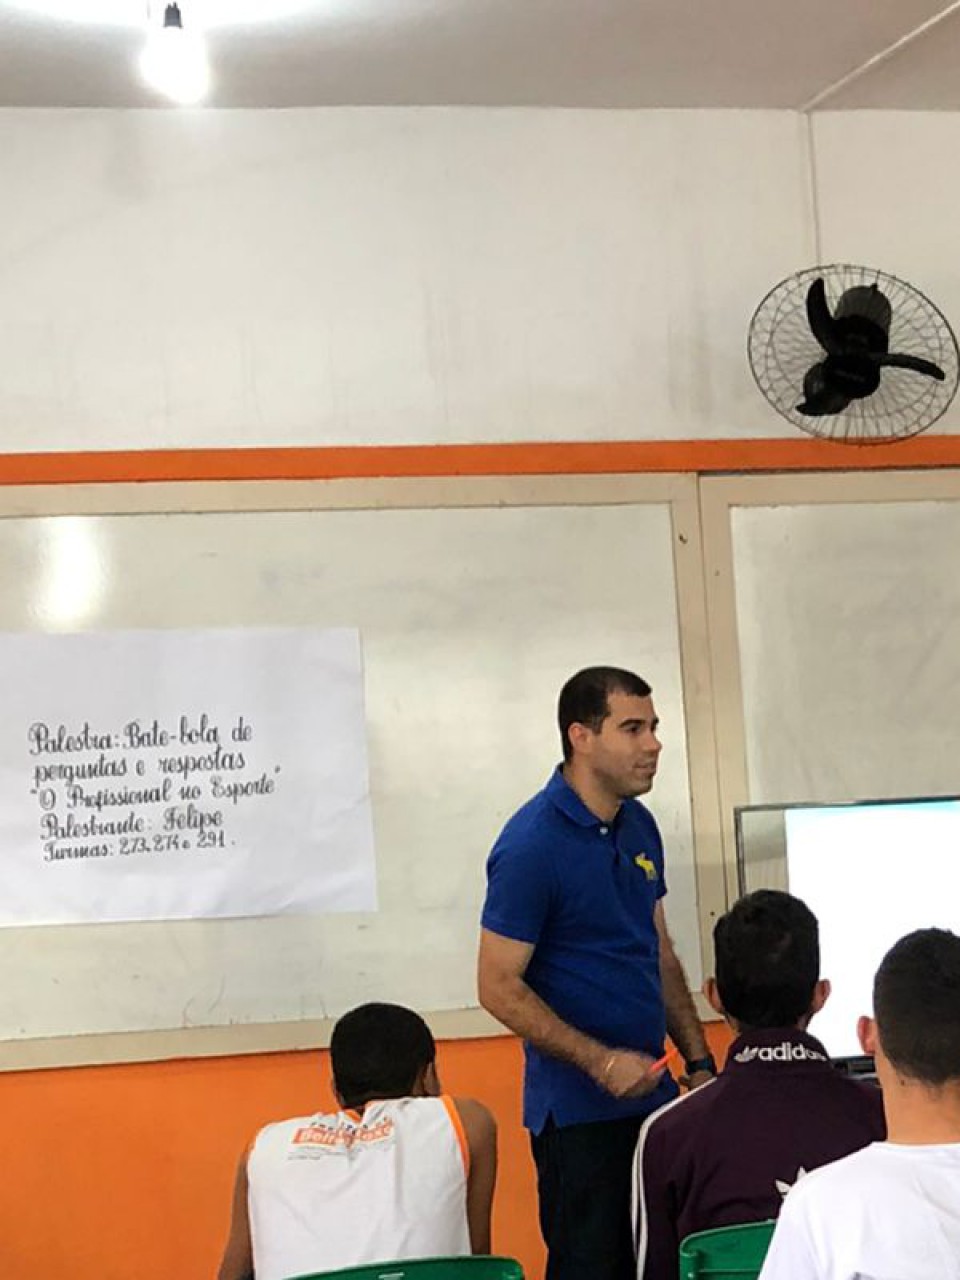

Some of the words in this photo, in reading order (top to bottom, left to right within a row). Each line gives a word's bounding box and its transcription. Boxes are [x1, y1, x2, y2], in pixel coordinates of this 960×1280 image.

[28, 722, 119, 755] Palestra:
[231, 716, 252, 742] de
[34, 753, 127, 788] perguntas
[136, 759, 146, 777] e
[158, 744, 245, 780] respostas
[67, 777, 172, 811] Profissional
[179, 785, 202, 801] no
[163, 803, 223, 834] Felipe
[43, 841, 113, 862] Turmas:
